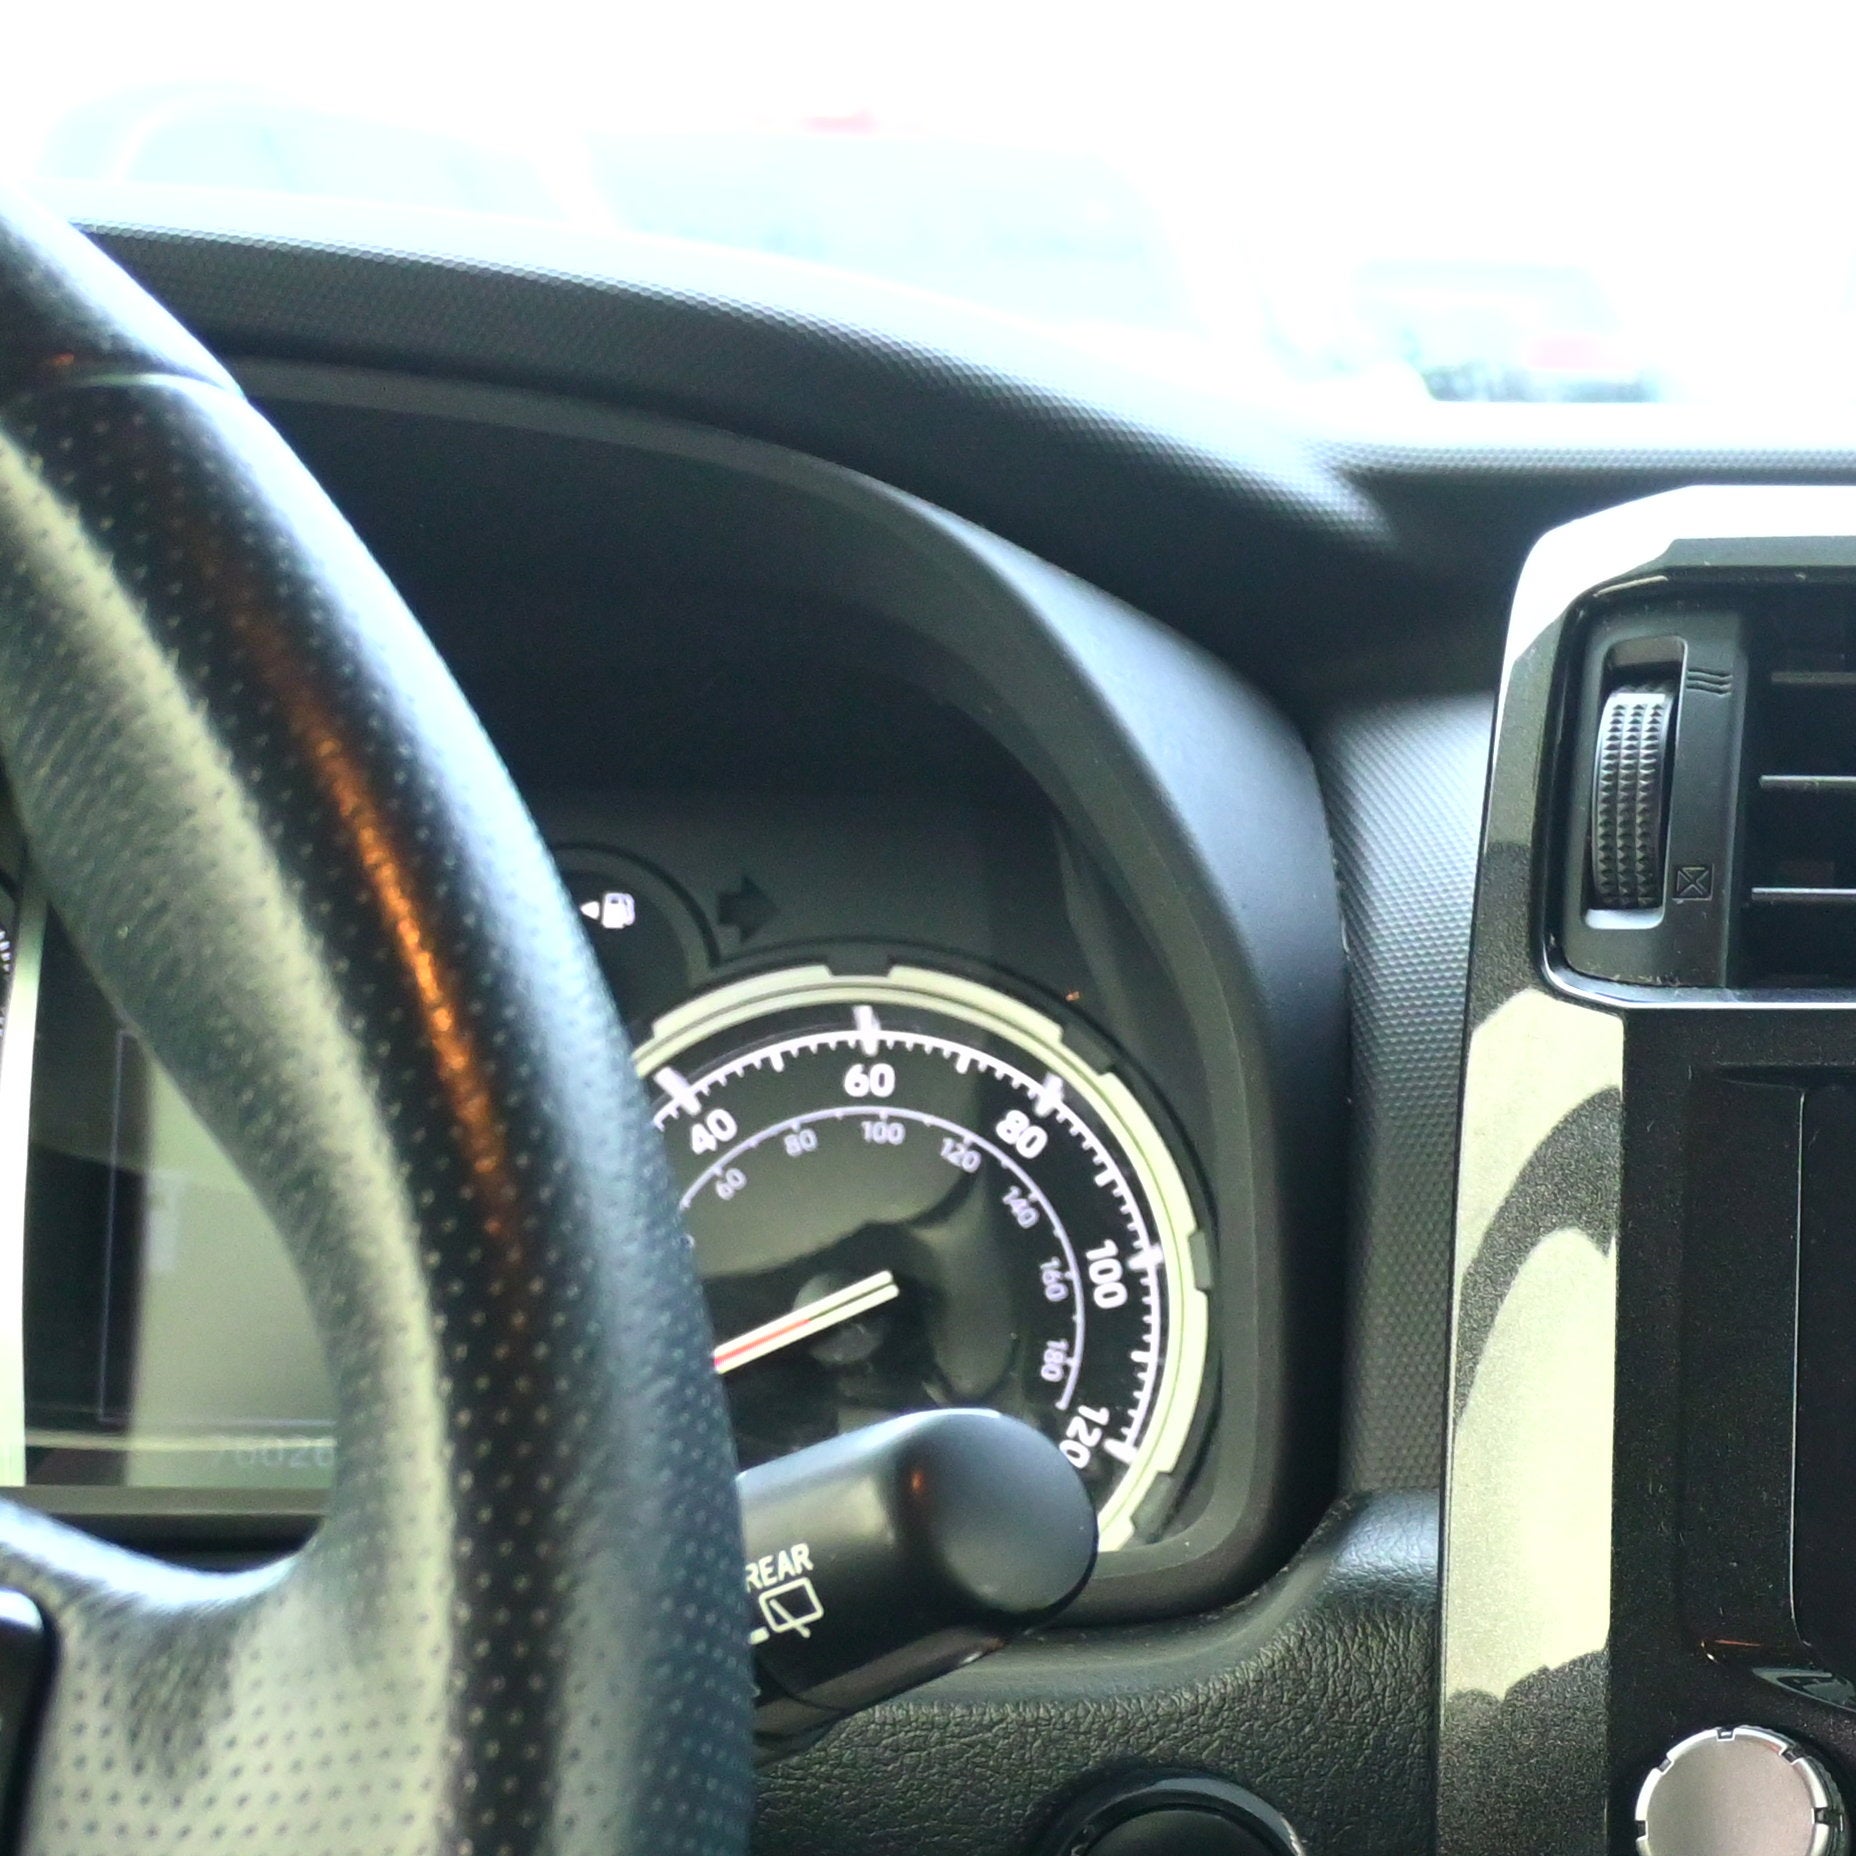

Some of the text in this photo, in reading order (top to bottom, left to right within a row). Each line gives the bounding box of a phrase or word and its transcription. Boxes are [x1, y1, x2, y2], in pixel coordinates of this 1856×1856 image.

[843, 1061, 895, 1098] 60
[691, 1108, 738, 1155] 40
[783, 1126, 818, 1157] 80
[861, 1118, 905, 1146] 100
[996, 1110, 1048, 1160] 80
[940, 1138, 980, 1174] 120
[715, 1167, 747, 1200] 60
[1003, 1186, 1040, 1229] 140
[1040, 1260, 1067, 1303] 160
[1085, 1239, 1128, 1310] 100
[1041, 1338, 1069, 1382] 180
[1059, 1404, 1110, 1469] 120
[745, 1543, 814, 1593] REAR
